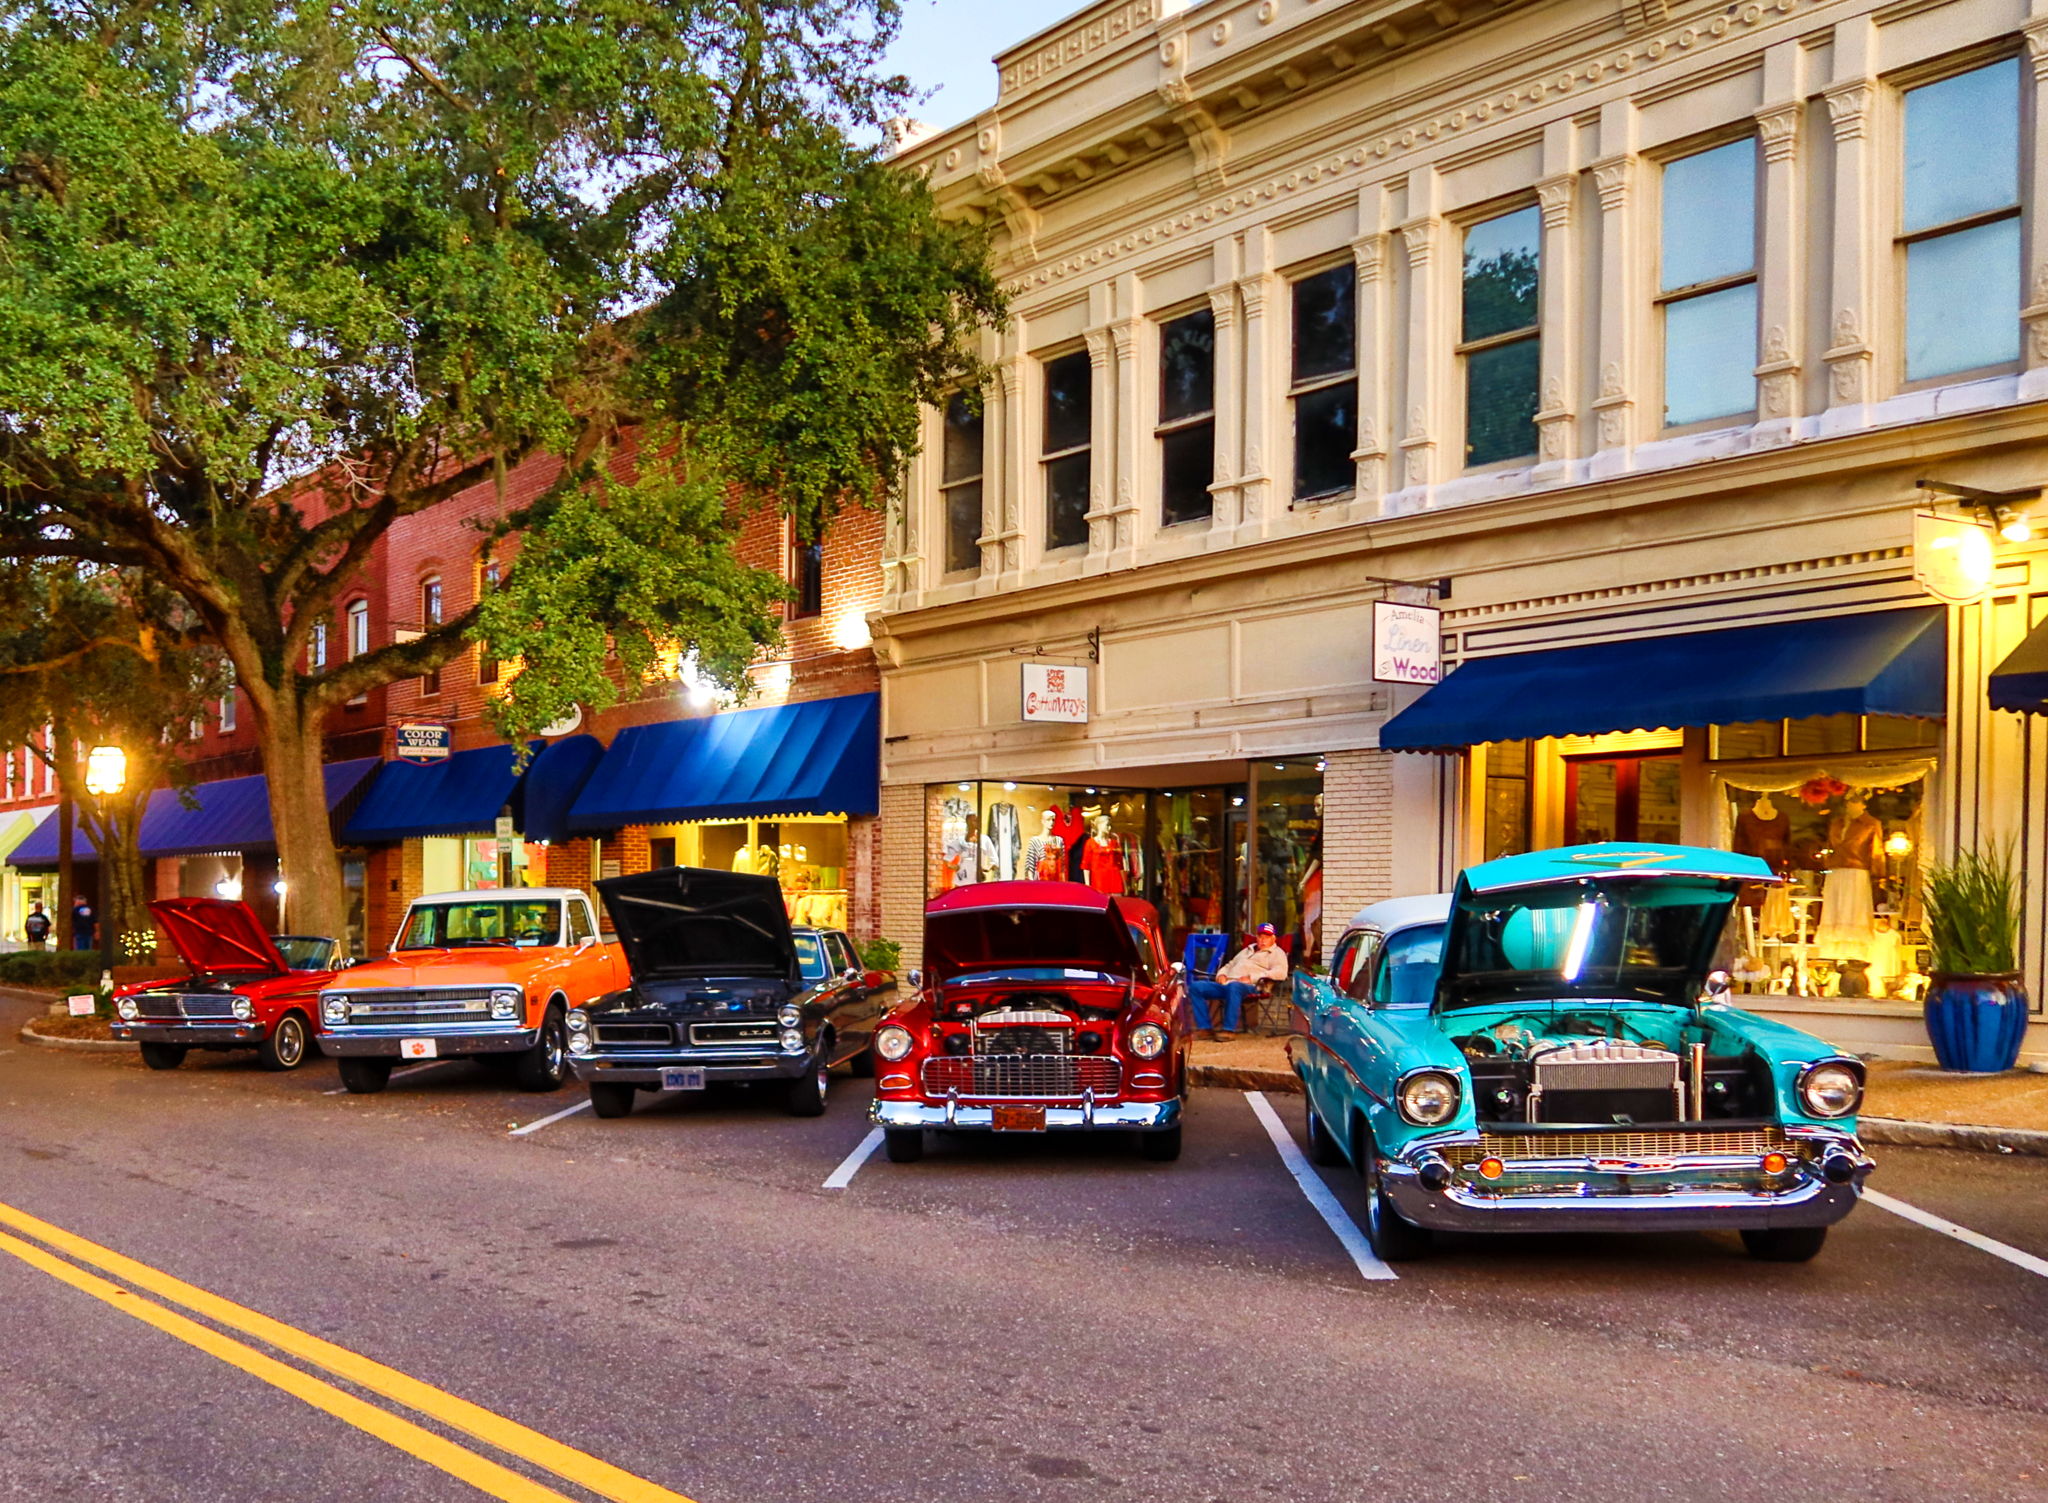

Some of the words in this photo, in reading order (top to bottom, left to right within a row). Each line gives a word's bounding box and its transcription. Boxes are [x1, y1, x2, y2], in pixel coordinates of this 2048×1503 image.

[1383, 623, 1432, 654] Linen
[1393, 656, 1438, 681] Wood
[404, 730, 442, 739] COLOR
[407, 739, 440, 747] WEAR
